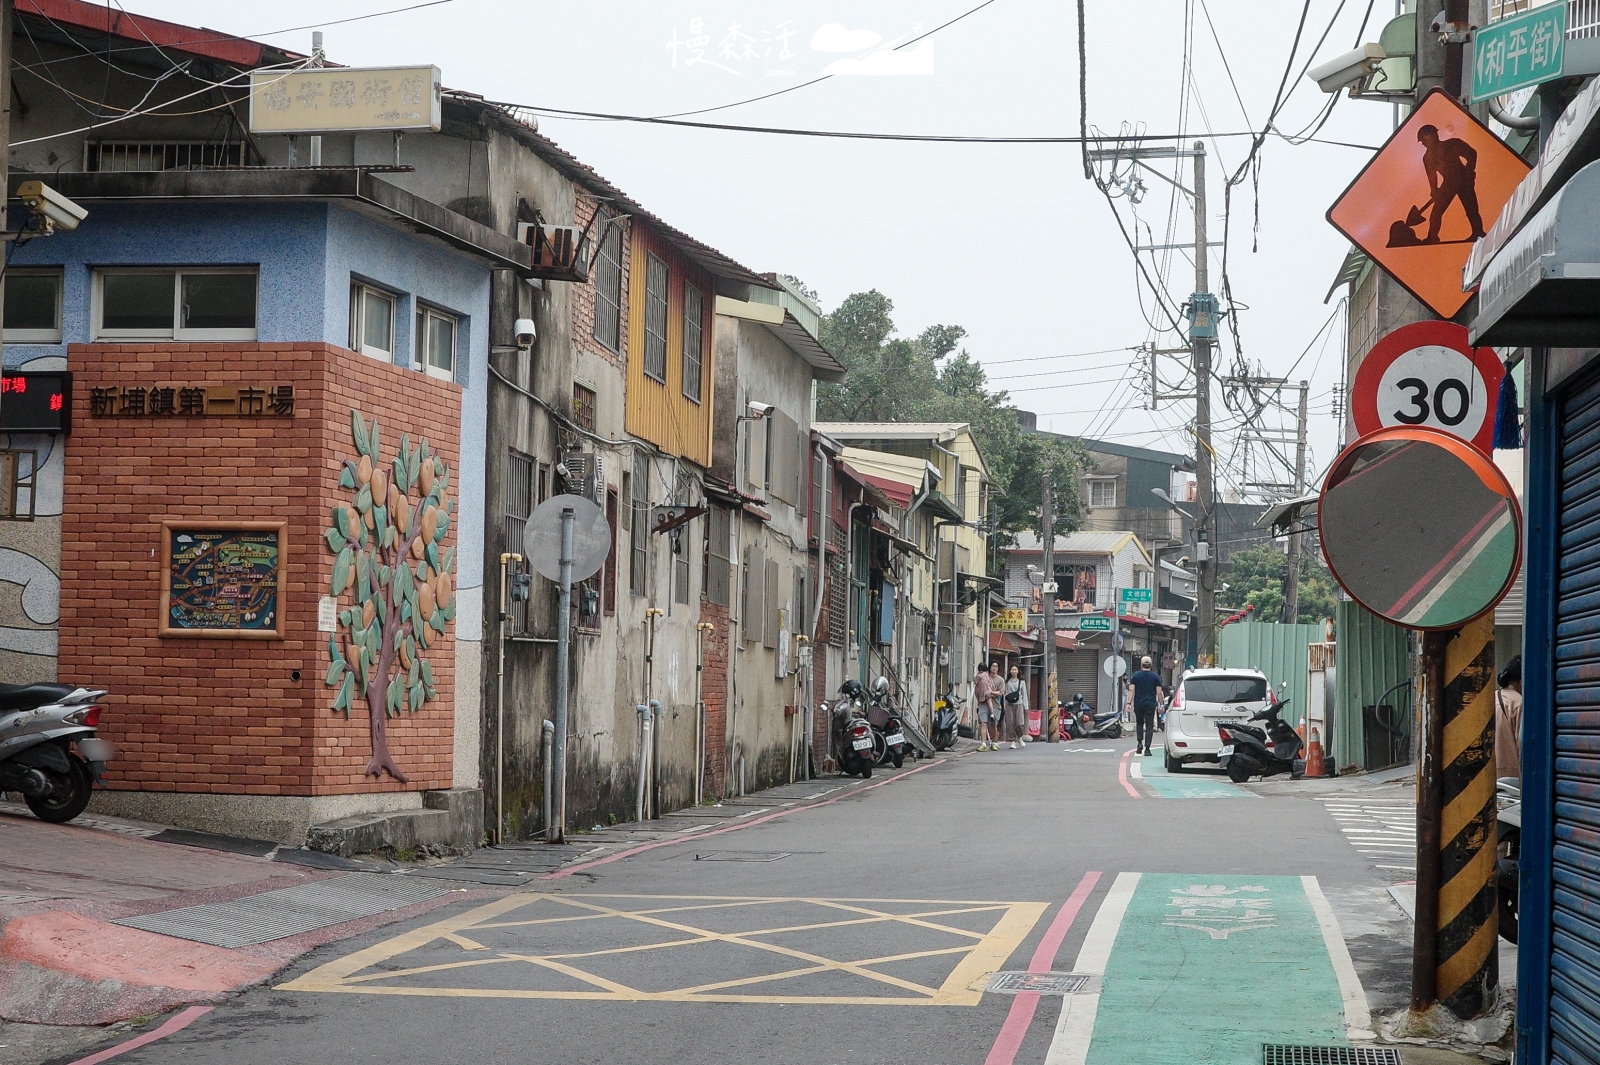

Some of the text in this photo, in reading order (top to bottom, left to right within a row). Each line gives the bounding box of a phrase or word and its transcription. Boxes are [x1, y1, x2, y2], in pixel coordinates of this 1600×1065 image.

[1485, 20, 1552, 84] 和平街
[90, 385, 296, 416] 新埔鎮第一市場
[1393, 377, 1470, 427] 30
